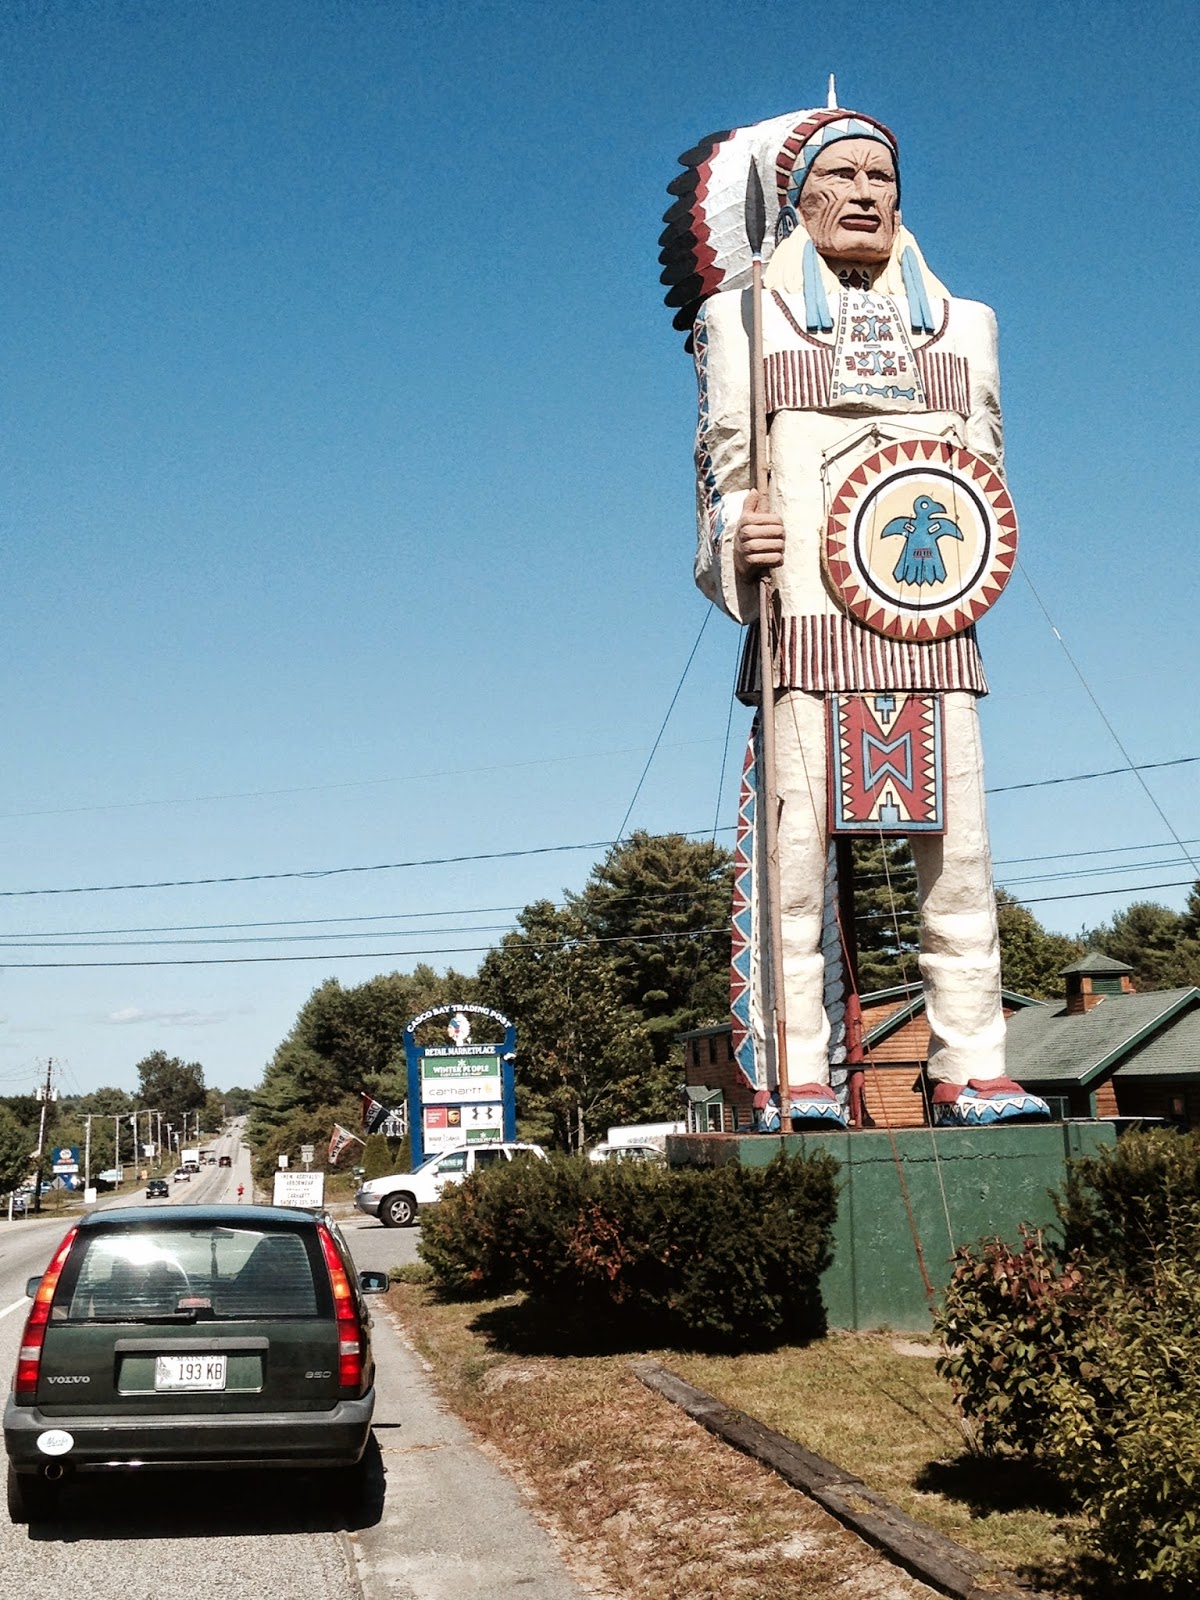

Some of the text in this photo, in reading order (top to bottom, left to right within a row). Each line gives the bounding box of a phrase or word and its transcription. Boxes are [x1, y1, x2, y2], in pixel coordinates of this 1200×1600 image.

[406, 1004, 512, 1033] CASCO BAY TRADING POST
[424, 1046, 496, 1056] RETAIL MARKETPLACE
[432, 1066, 463, 1074] WINTER
[463, 1065, 490, 1073] PEOPLE
[428, 1087, 482, 1096] carhartt
[179, 1363, 223, 1380] 193 KB
[304, 1371, 332, 1379] 850
[47, 1375, 91, 1385] VOLVO
